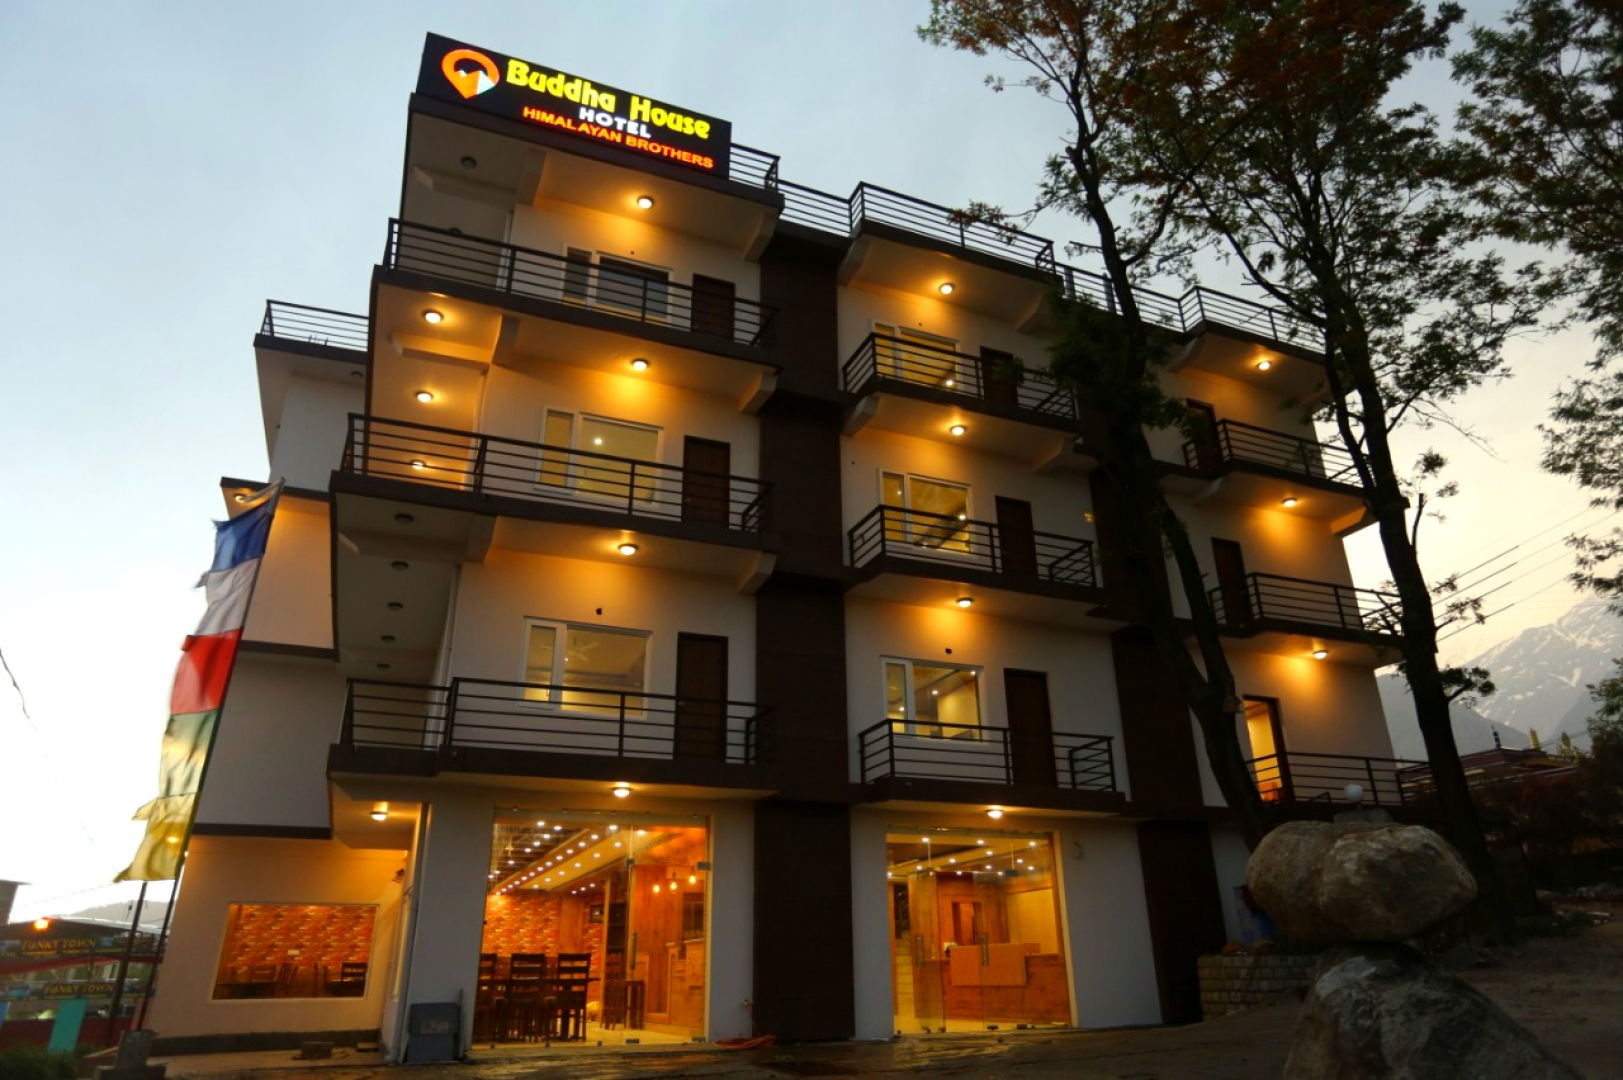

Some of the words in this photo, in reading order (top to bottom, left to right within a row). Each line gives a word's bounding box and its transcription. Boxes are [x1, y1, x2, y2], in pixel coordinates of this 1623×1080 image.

[506, 59, 616, 113] Buddha
[629, 95, 711, 139] House
[522, 106, 622, 143] HIMALAYAN
[625, 136, 714, 168] BROTHERS
[579, 107, 651, 138] HOTEL
[62, 938, 96, 948] TOWN
